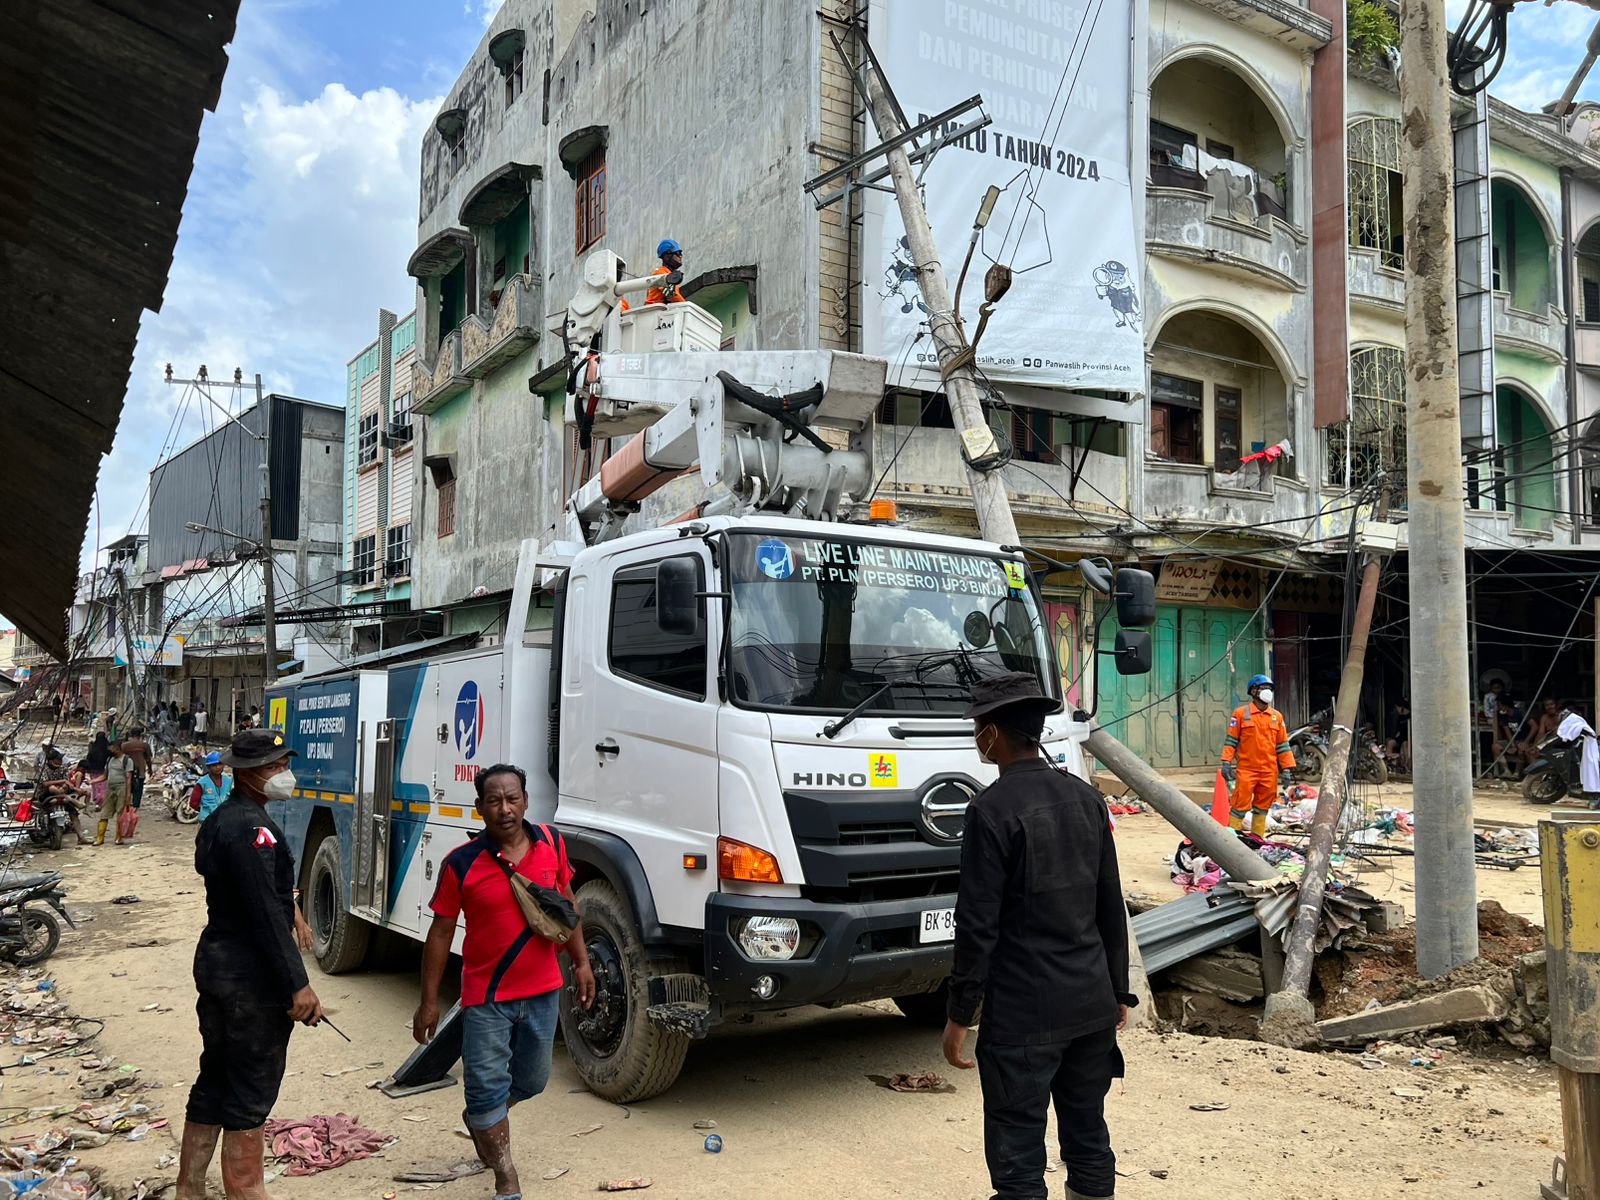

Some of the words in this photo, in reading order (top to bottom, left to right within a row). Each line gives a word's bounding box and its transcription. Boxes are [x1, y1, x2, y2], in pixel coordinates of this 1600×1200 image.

[918, 30, 963, 70] DAN
[944, 0, 1079, 68] PEMUNGUTAN
[918, 113, 987, 154] PMILU
[993, 132, 1052, 170] TAHUN
[1056, 150, 1100, 182] 2024
[1045, 360, 1081, 370] Panwaslih
[1113, 364, 1131, 372] Aceh
[802, 541, 845, 563] LIVE
[847, 543, 888, 567] LINE
[890, 548, 1000, 580] MAINTENANCE
[829, 568, 859, 583] PLN
[863, 571, 940, 593] (PERSERO)
[942, 577, 967, 592] UP3
[970, 581, 1008, 598] BINJAI
[793, 772, 867, 787] HINO
[924, 913, 940, 931] BK
